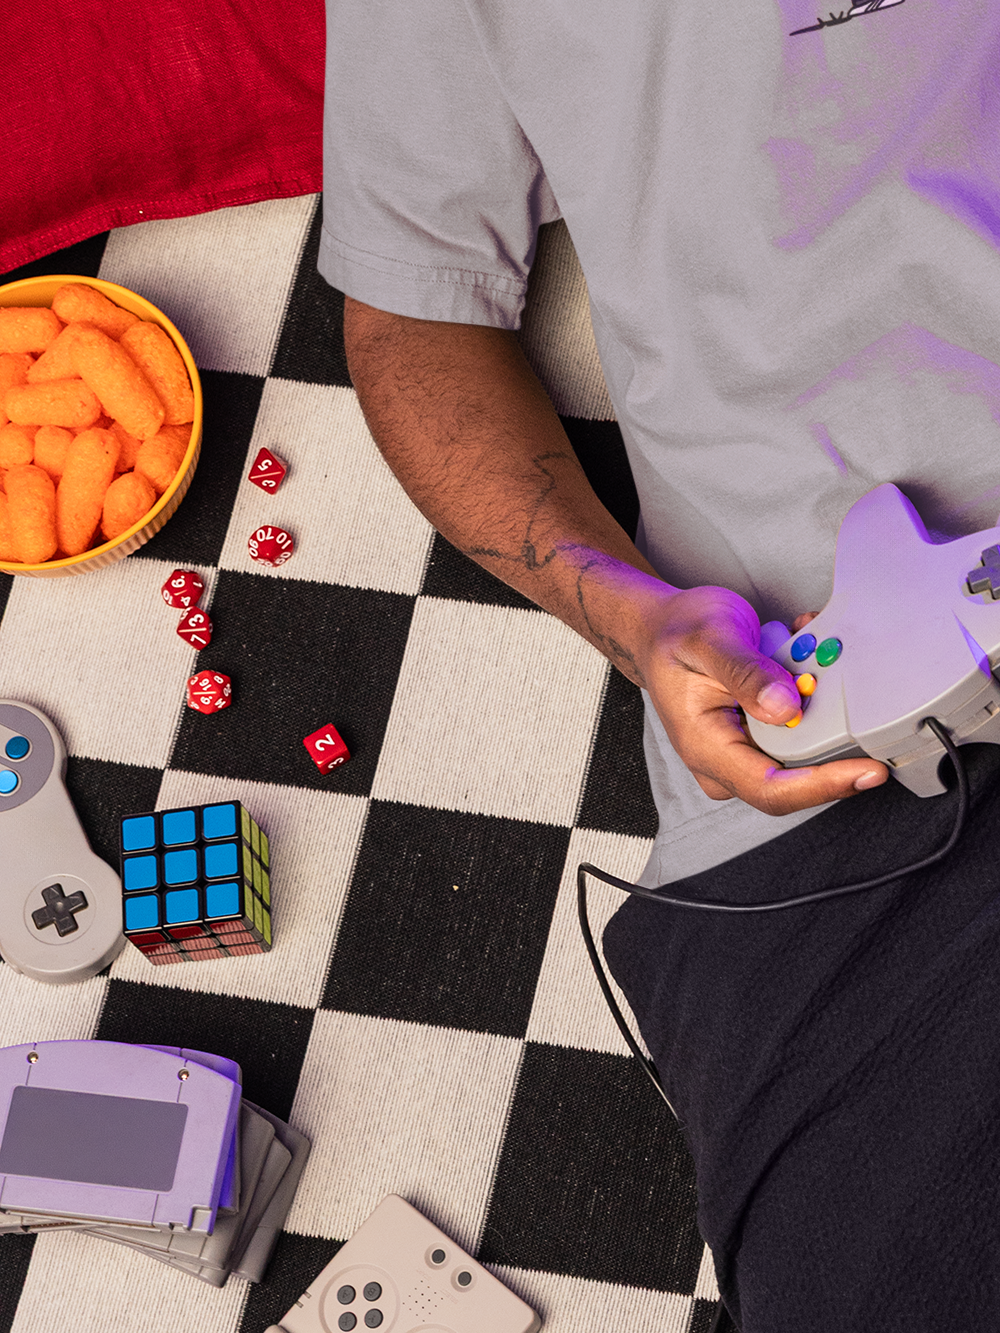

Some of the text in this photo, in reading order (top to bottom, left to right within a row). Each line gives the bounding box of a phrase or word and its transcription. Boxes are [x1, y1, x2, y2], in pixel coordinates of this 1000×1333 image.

[257, 459, 273, 471] 5
[261, 479, 276, 488] 3
[256, 527, 275, 542] 70
[275, 532, 292, 550] 10
[180, 596, 191, 607] 4
[188, 613, 205, 627] 3
[199, 678, 212, 691] 16
[314, 733, 336, 752] 2
[327, 757, 344, 769] 3
